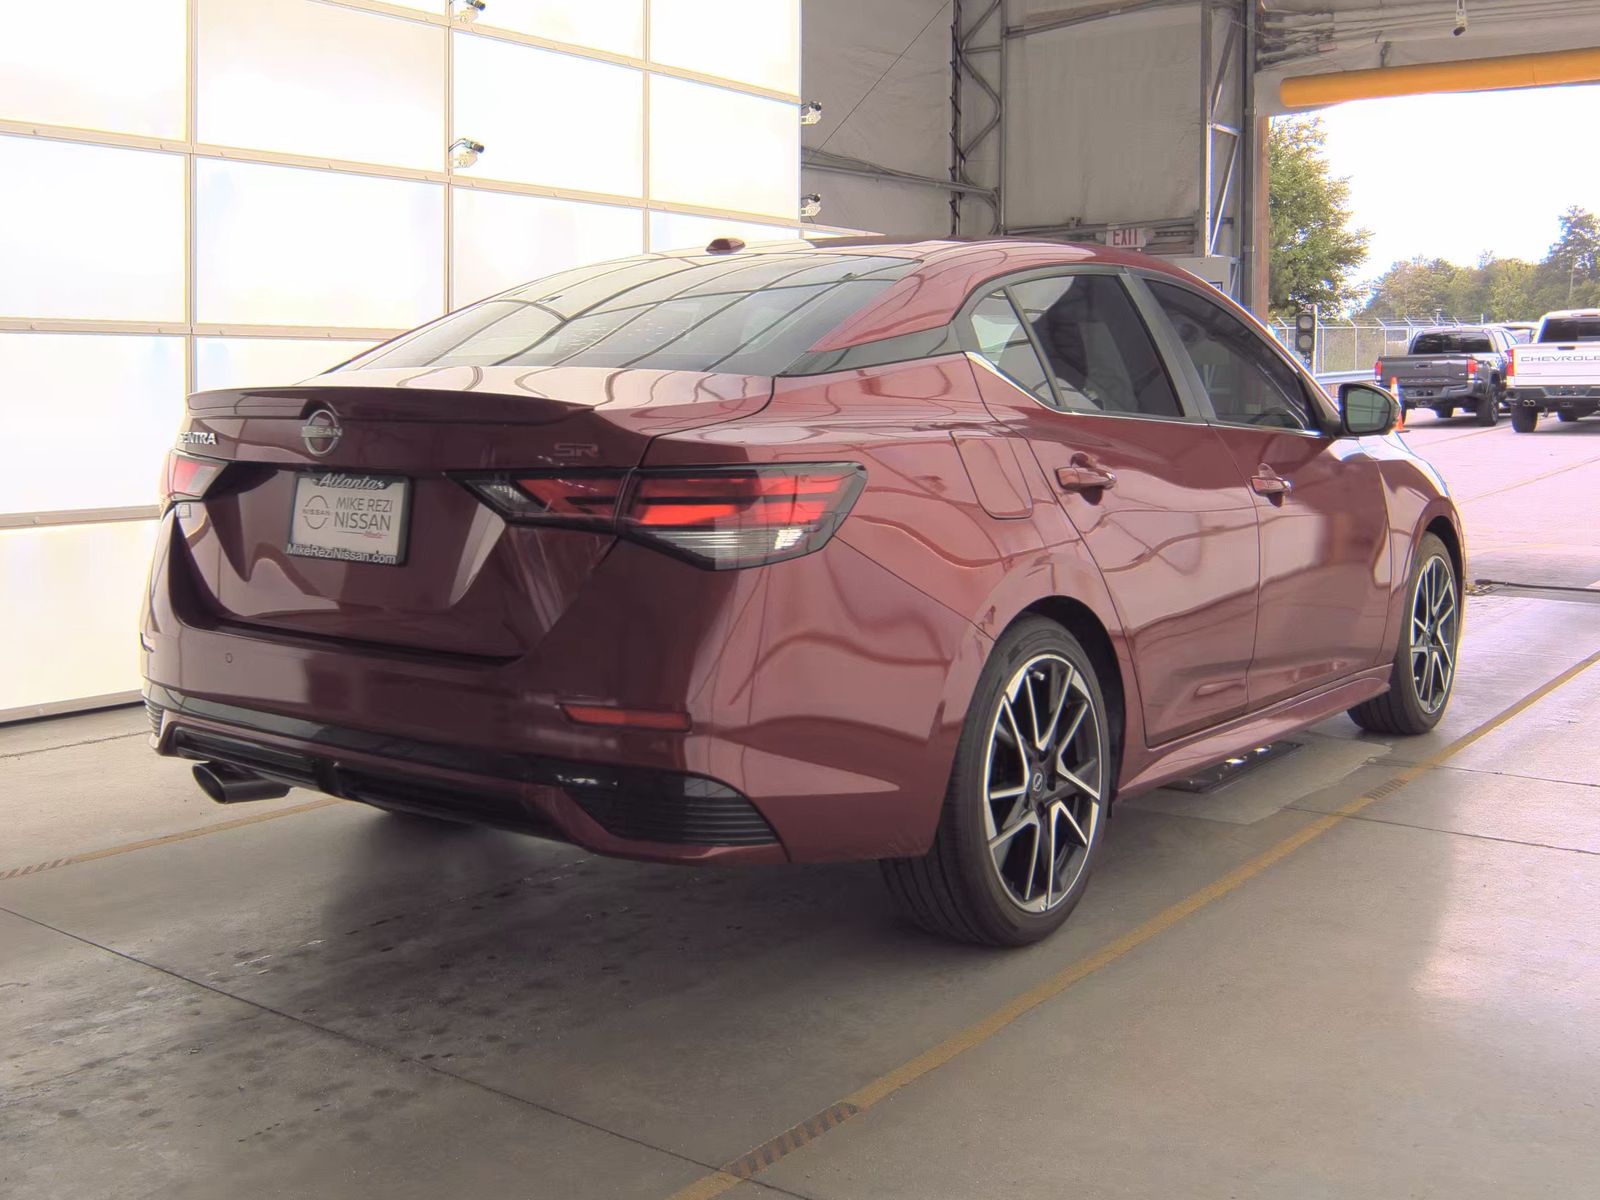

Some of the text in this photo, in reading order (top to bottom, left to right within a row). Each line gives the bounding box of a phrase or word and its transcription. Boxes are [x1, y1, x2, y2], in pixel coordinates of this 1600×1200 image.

[1112, 228, 1138, 245] EXIT
[302, 426, 342, 437] SSAN
[553, 442, 599, 458] SR
[318, 472, 380, 490] Atlanta
[335, 497, 393, 513] MIKE REZI
[334, 511, 392, 531] NISSAN
[286, 543, 397, 564] MikeReziNissan.com
